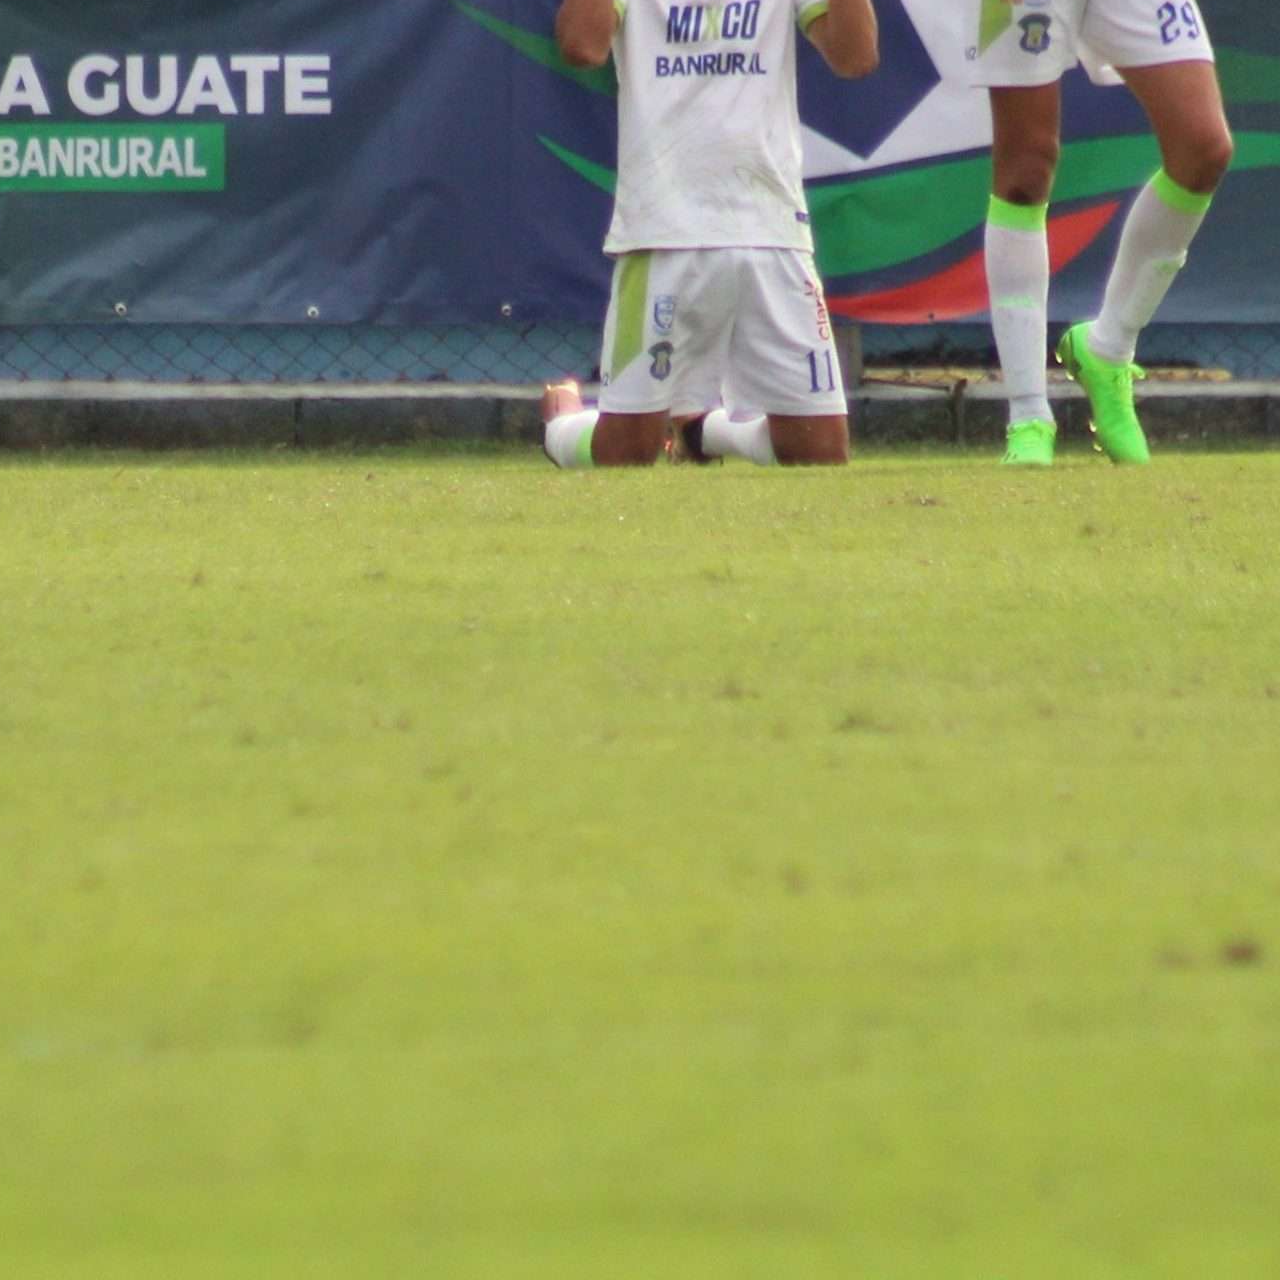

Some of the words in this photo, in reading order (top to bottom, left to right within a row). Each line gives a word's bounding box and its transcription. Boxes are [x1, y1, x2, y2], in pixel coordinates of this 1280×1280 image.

[666, 0, 760, 44] MIXCO
[1156, 1, 1200, 45] 29
[67, 54, 332, 116] GUATE
[807, 349, 835, 393] 11
